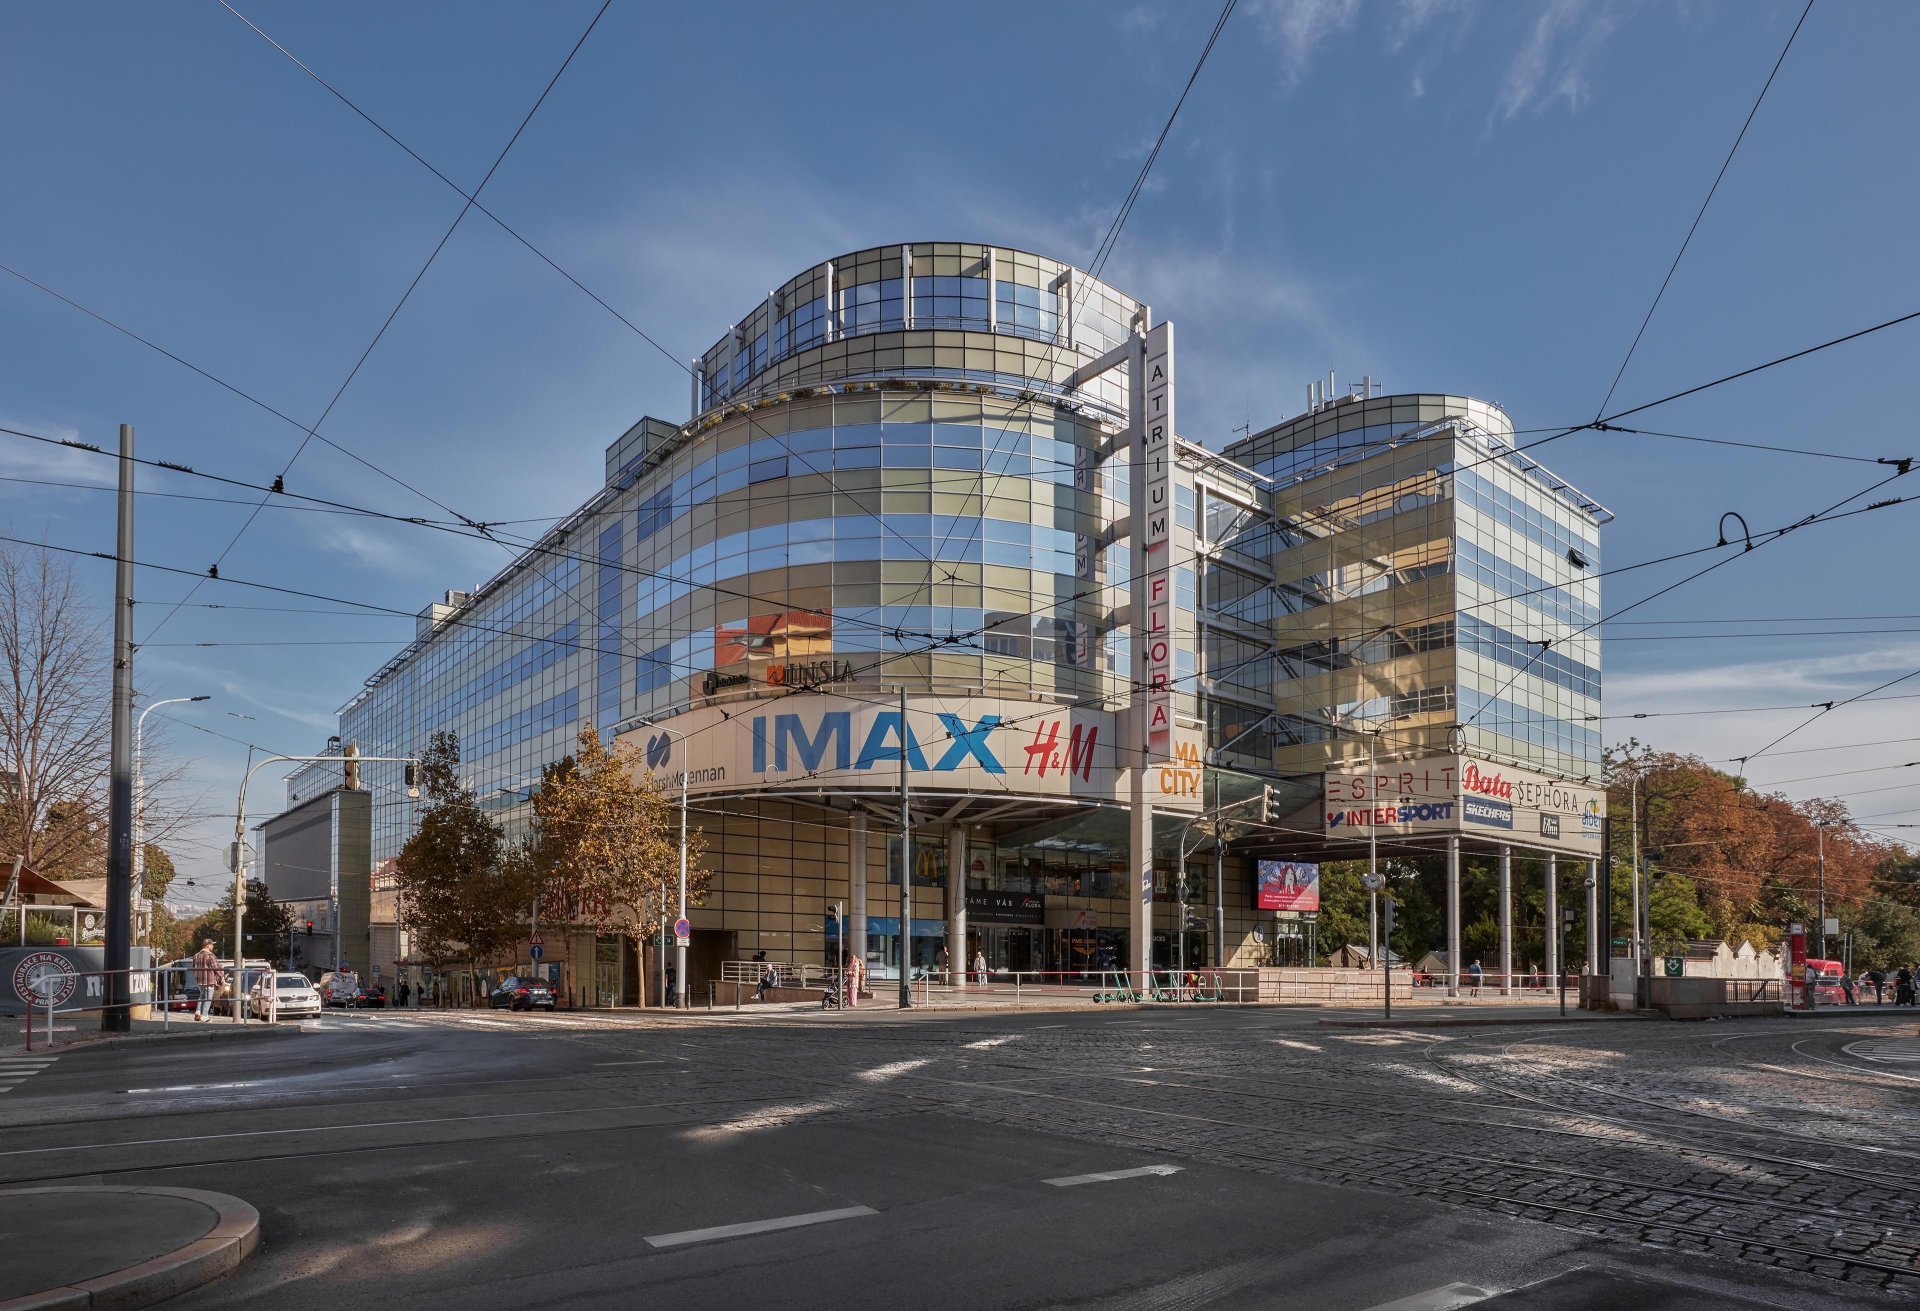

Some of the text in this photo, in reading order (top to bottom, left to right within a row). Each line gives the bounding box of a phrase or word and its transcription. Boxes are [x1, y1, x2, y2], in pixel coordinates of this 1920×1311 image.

[1151, 364, 1165, 537] ATRIUM
[1151, 578, 1168, 726] FLORA
[753, 711, 1007, 774] IMAX
[1023, 719, 1099, 783] H&M
[646, 766, 726, 792] arshMcennan
[1160, 767, 1201, 798] CITY
[1328, 767, 1456, 802] ESPRIT
[1518, 780, 1579, 813] SEPHORA
[1346, 801, 1454, 827] INTERSPORT
[1465, 803, 1512, 822] SKECHERS
[1582, 809, 1601, 829] alber
[965, 896, 988, 906] TÁME
[35, 997, 59, 1006] PRAA
